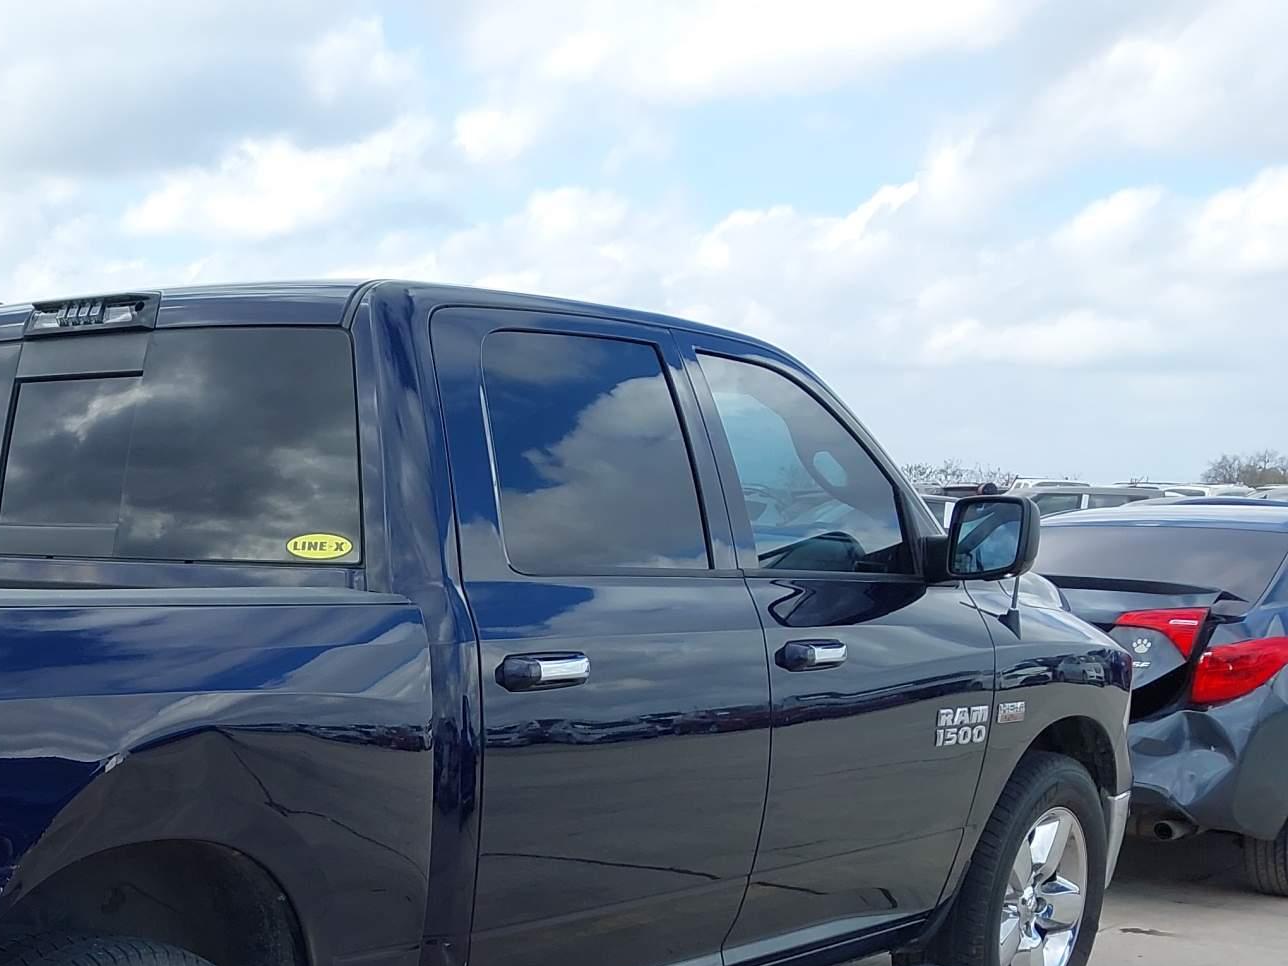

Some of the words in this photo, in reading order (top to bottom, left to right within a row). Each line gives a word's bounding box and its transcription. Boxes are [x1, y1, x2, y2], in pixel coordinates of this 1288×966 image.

[292, 540, 345, 552] LINE-X
[937, 705, 989, 727] RAM
[935, 725, 986, 747] 1500
